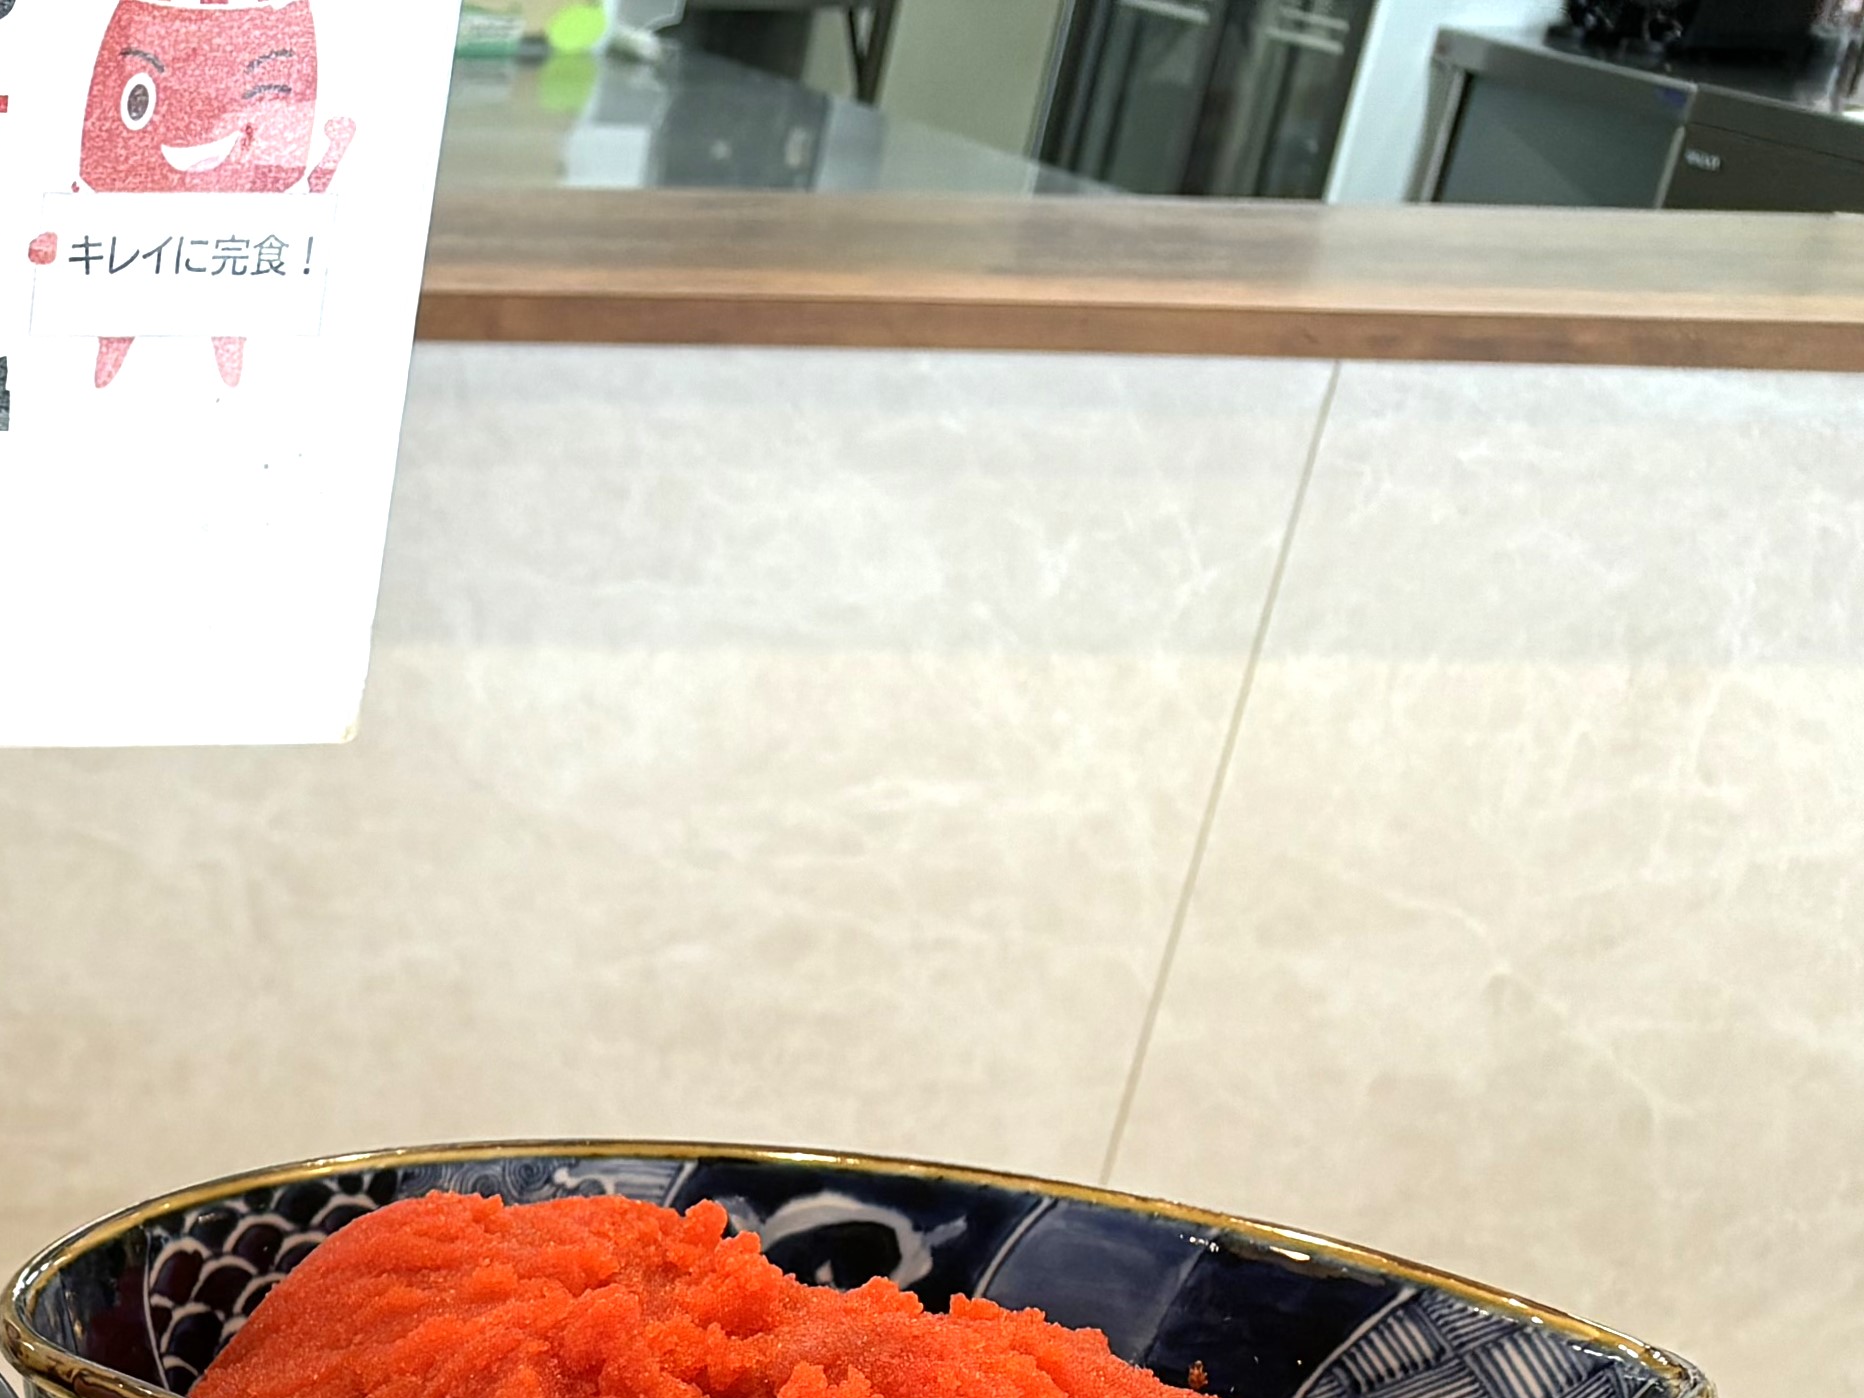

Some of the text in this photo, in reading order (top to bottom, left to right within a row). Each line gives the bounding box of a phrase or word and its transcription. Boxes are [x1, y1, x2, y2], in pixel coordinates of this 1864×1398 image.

[68, 235, 314, 276] キレイに完食!
